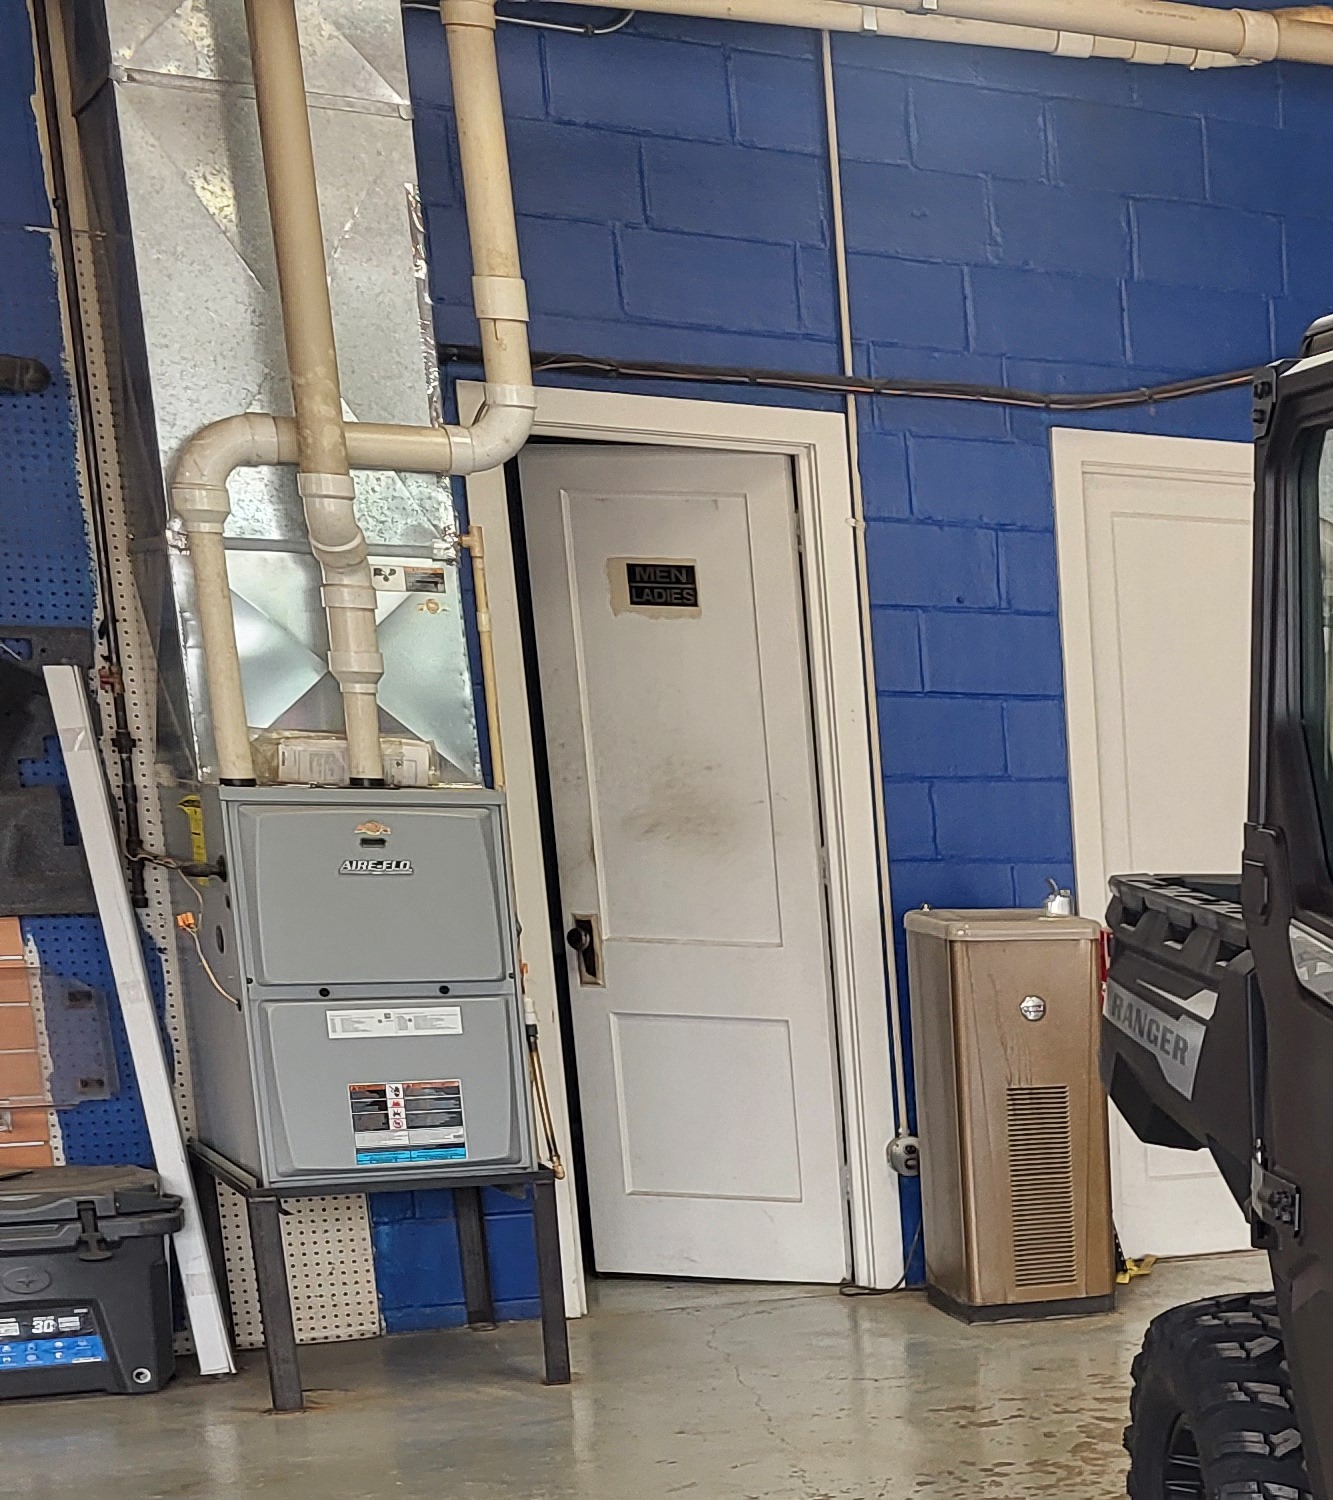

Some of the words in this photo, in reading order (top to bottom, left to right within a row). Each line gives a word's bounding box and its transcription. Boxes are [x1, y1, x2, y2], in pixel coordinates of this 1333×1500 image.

[634, 566, 687, 583] MEN
[631, 587, 695, 604] LADIES
[340, 860, 412, 873] AIRE-FLO
[1111, 991, 1188, 1066] RANGER
